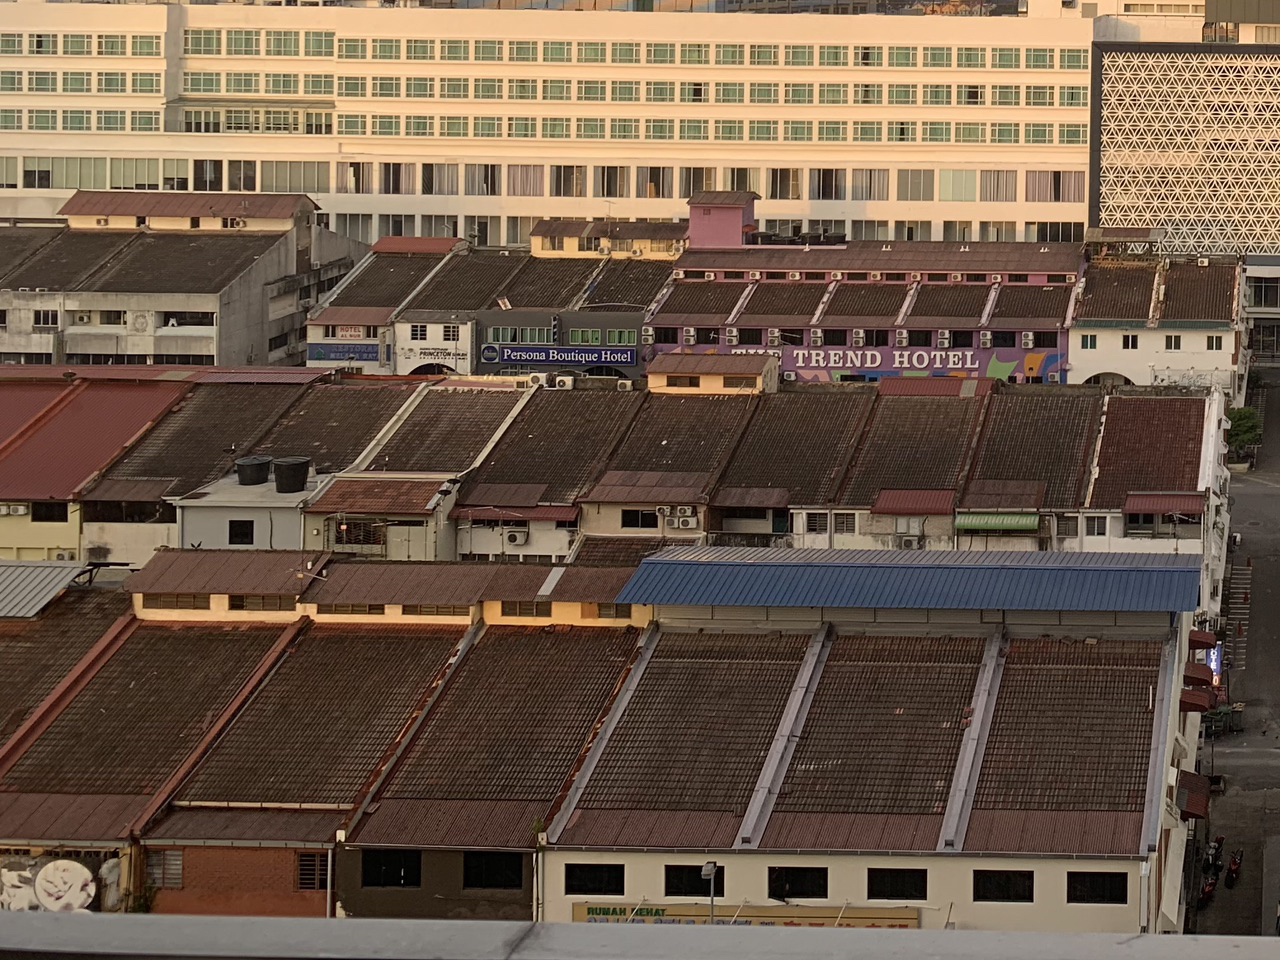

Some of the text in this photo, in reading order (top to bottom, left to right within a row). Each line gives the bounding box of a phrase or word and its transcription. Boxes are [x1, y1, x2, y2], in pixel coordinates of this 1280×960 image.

[503, 349, 546, 360] Persona
[549, 349, 598, 364] Boutique
[601, 350, 631, 362] Hotel
[793, 350, 882, 368] TREND
[892, 351, 979, 369] HOTEL
[587, 907, 627, 916] RUMAH
